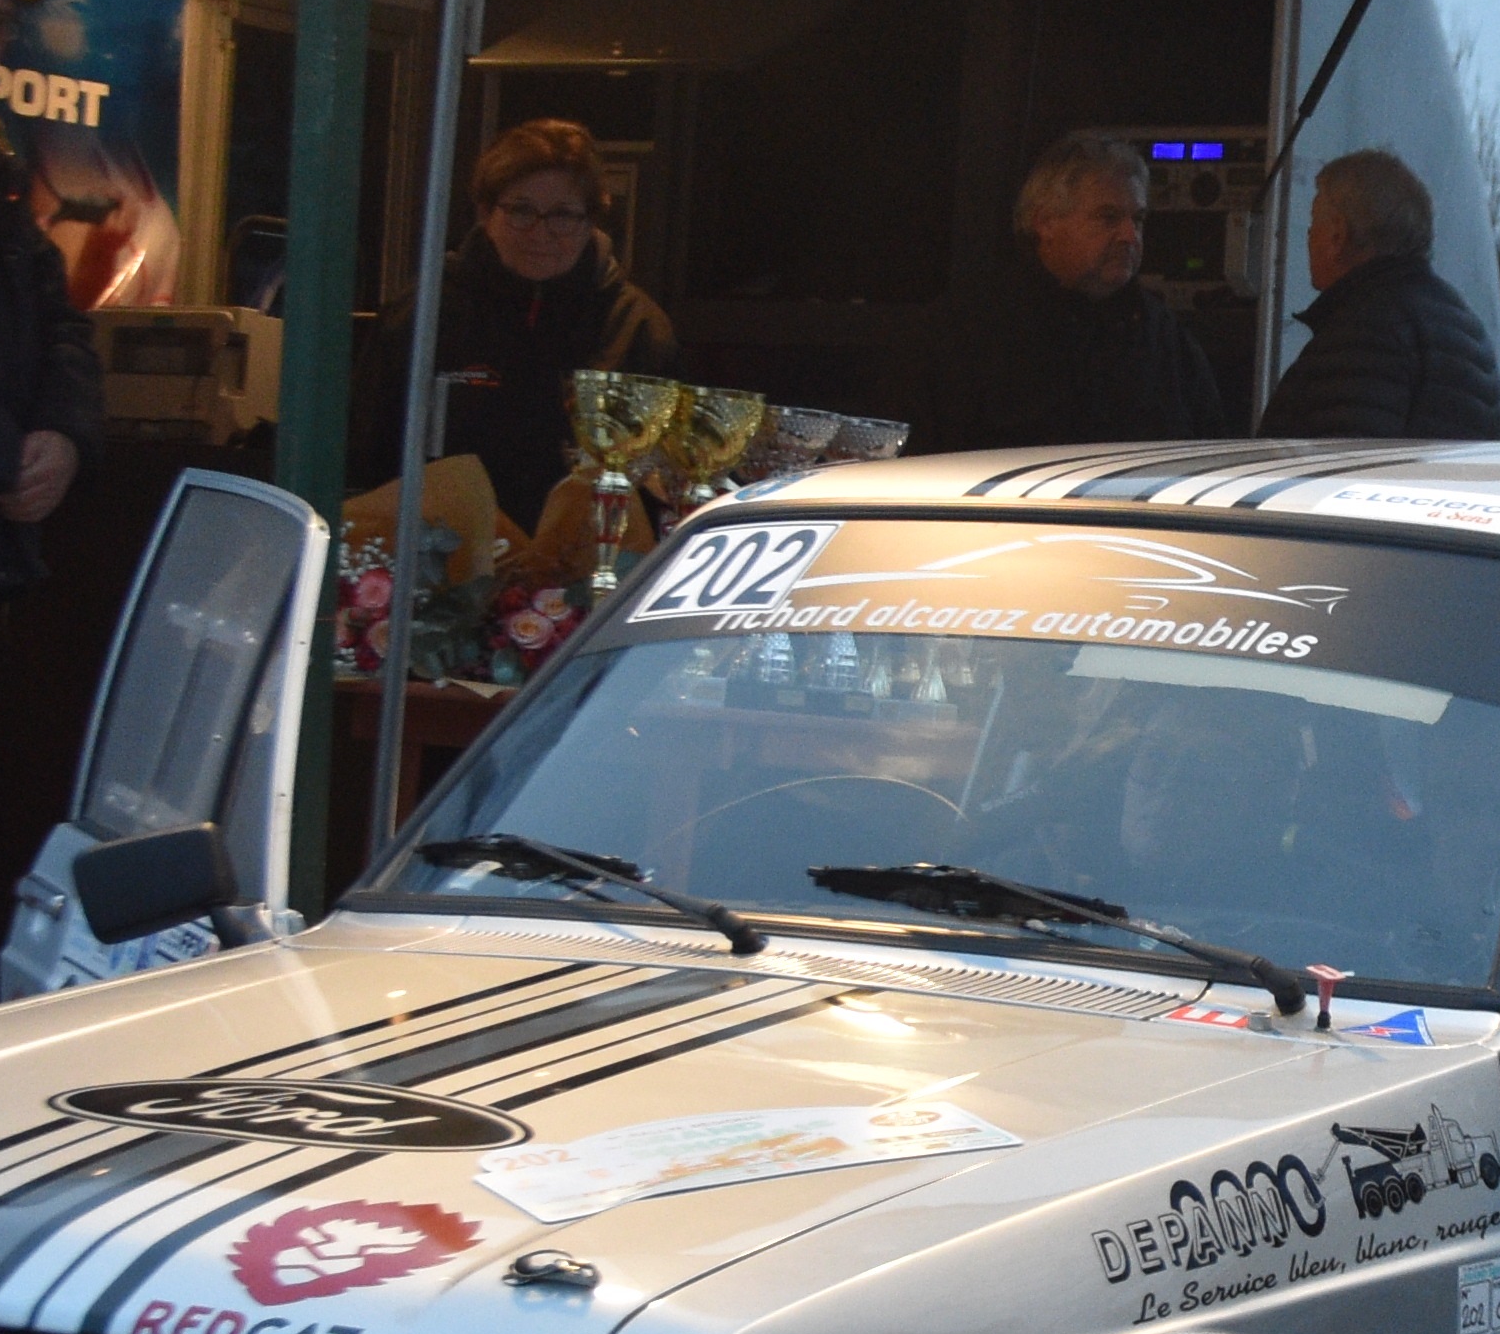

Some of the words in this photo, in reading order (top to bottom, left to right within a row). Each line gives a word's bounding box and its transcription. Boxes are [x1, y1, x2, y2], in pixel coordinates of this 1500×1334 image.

[649, 528, 818, 612] 202
[865, 596, 1030, 634] alcaraz
[1030, 604, 1320, 661] automobiles
[120, 1076, 430, 1149] Ford
[496, 1147, 574, 1175] 202
[1132, 1292, 1171, 1326] Le
[1179, 1272, 1279, 1312] Service
[1354, 1231, 1431, 1265] blanc,
[1462, 1302, 1486, 1329] 202
